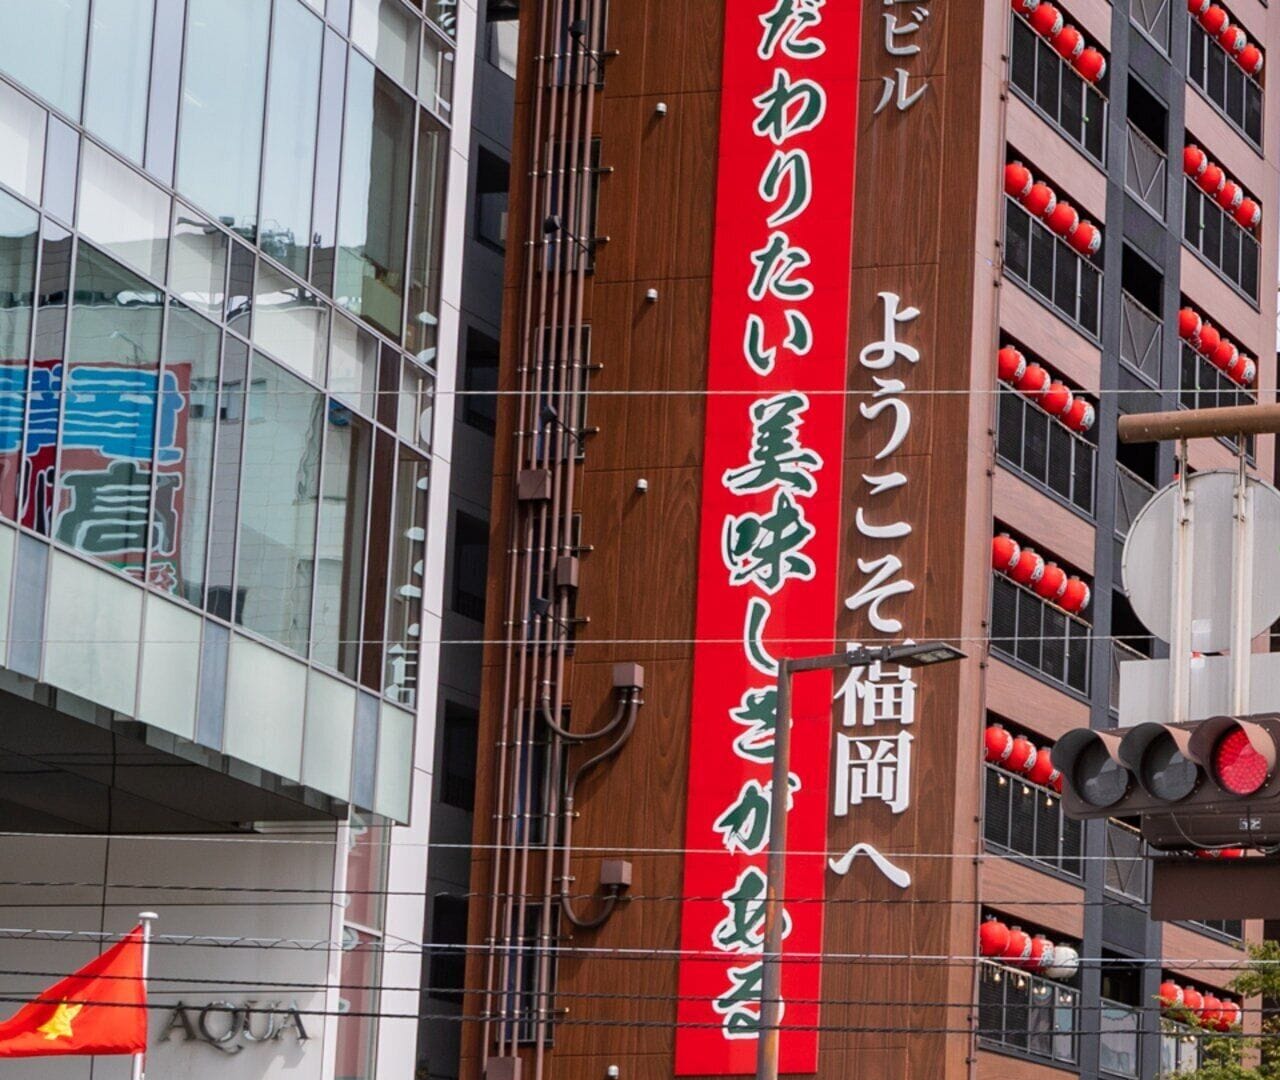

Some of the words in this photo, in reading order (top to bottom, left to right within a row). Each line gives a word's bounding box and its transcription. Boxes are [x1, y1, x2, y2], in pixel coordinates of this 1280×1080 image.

[873, 0, 930, 113] ビル
[828, 290, 921, 888] ようこそ福岡へ
[159, 1000, 311, 1054] AQUA
